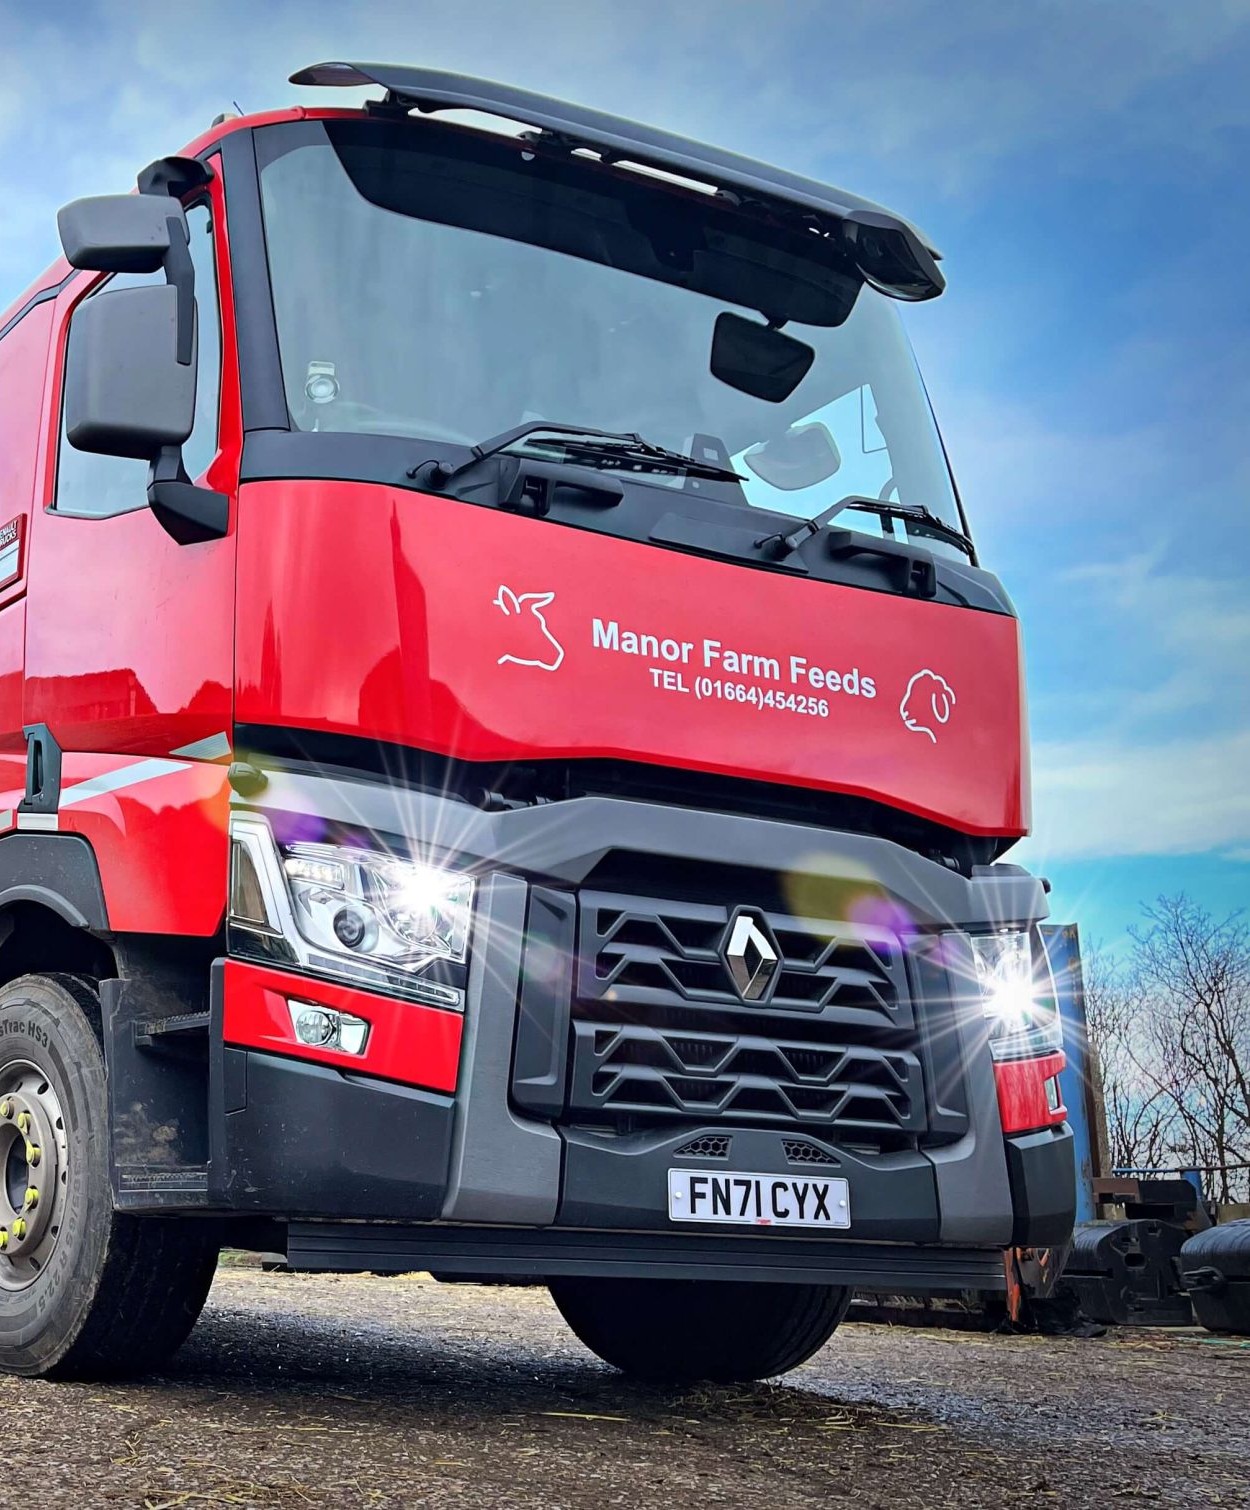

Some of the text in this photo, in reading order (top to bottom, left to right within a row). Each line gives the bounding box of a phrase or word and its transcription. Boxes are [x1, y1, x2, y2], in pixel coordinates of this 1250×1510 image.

[592, 618, 877, 699] Manor Farm Feeds
[649, 668, 830, 718] TEL (01664)454256
[27, 1020, 49, 1048] HS3
[689, 1176, 831, 1221] FN71 CYX
